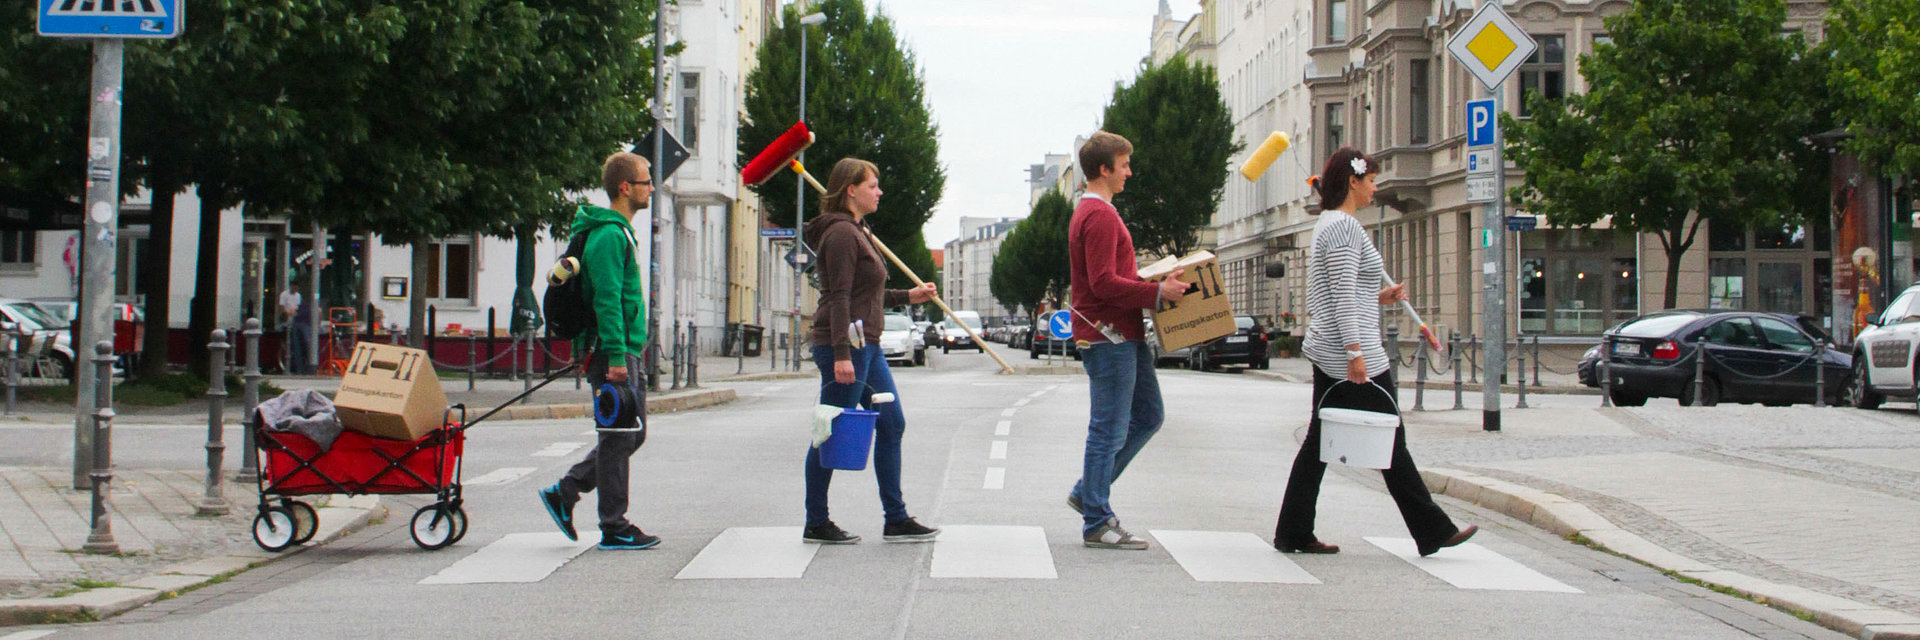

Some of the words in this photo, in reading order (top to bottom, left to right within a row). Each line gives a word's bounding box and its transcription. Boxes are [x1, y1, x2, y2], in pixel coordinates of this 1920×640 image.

[1472, 106, 1489, 142] P
[1163, 310, 1230, 334] Umzugskarton
[341, 384, 404, 400] Umzugskarton
